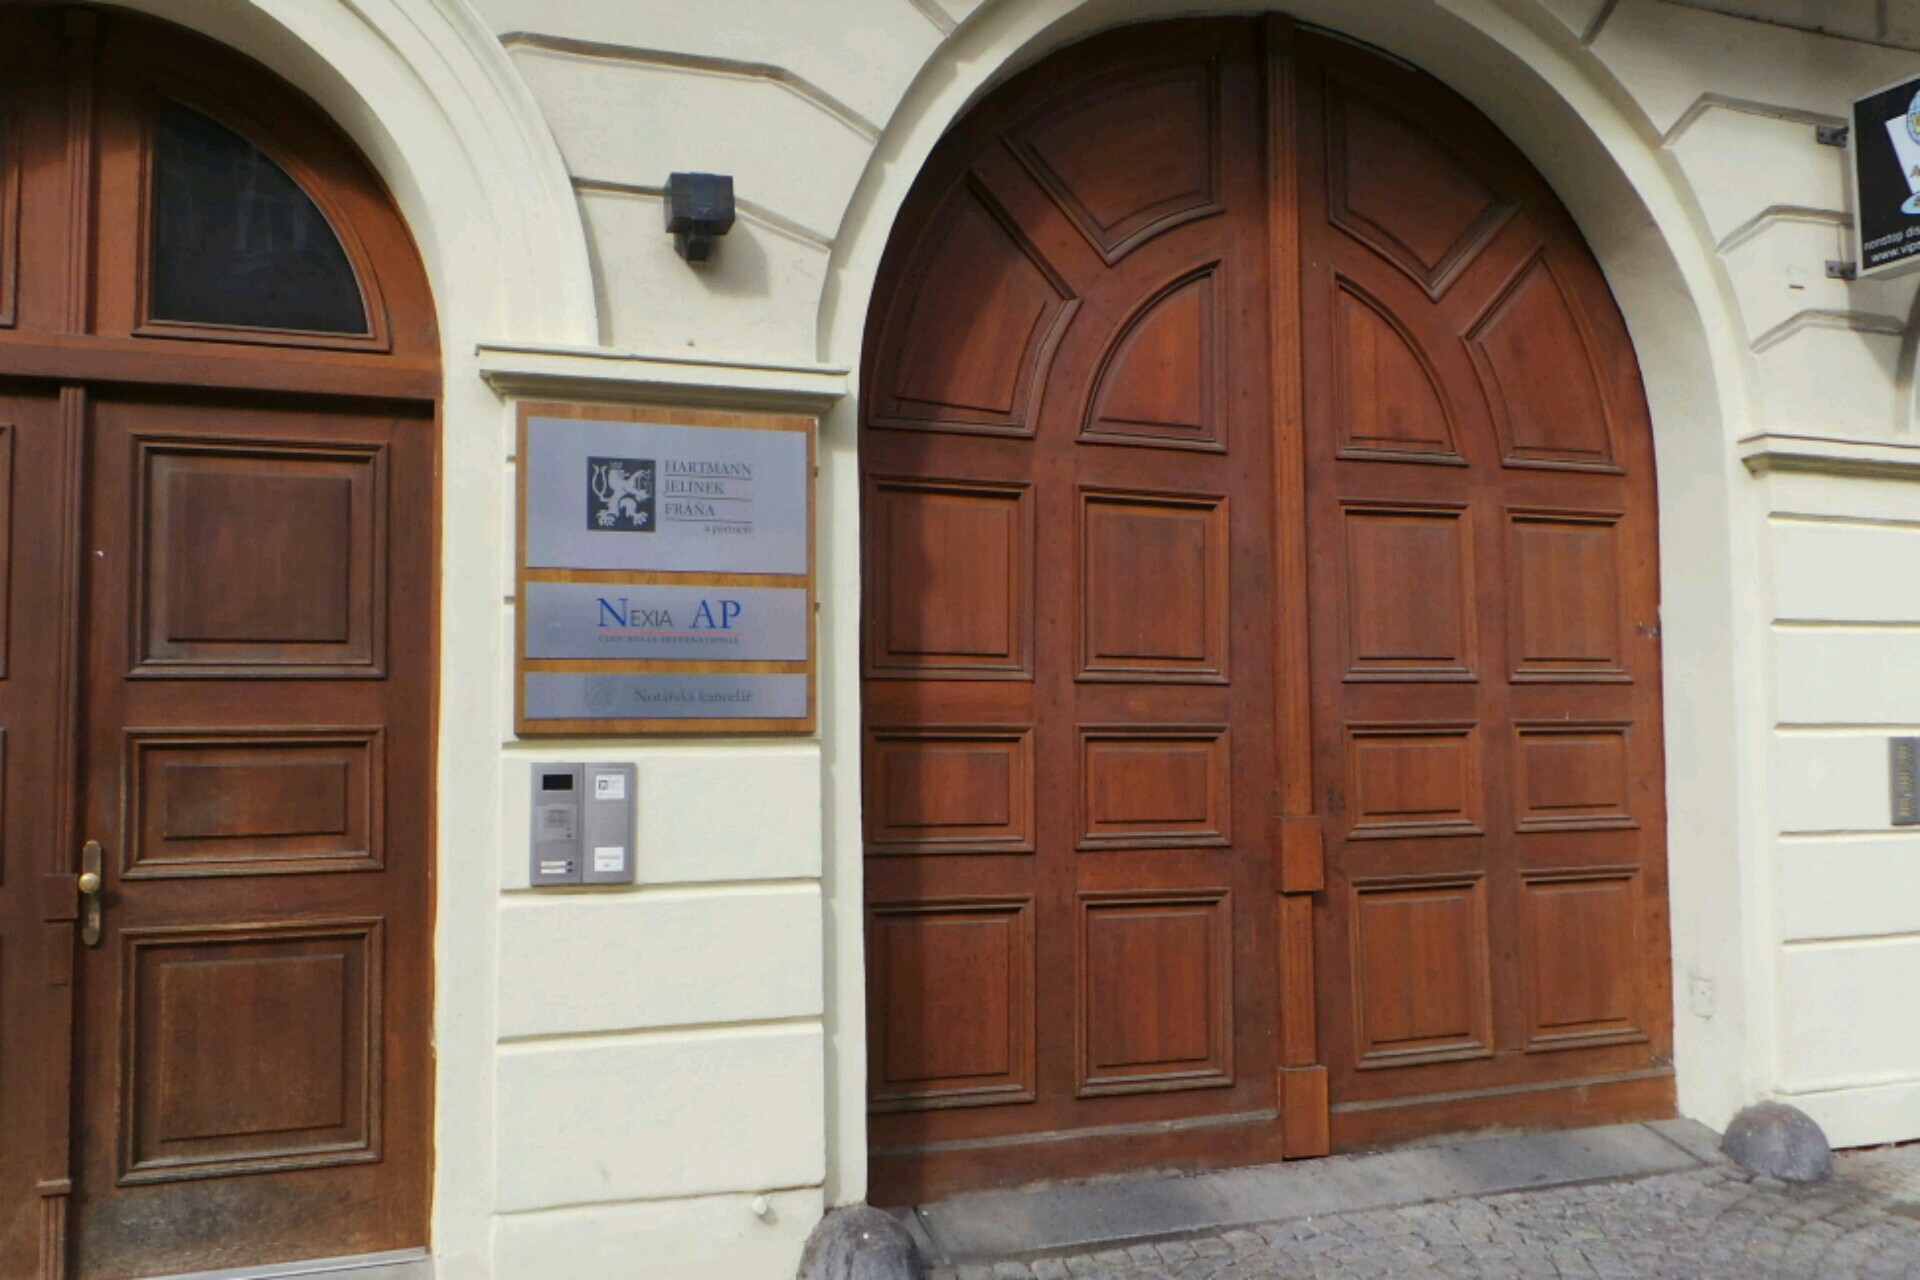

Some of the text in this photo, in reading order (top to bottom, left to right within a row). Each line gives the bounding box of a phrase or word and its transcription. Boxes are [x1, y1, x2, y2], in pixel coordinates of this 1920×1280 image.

[1864, 231, 1903, 252] nonstop
[665, 460, 753, 476] HARTMANN
[596, 598, 742, 629] NEXIA AP
